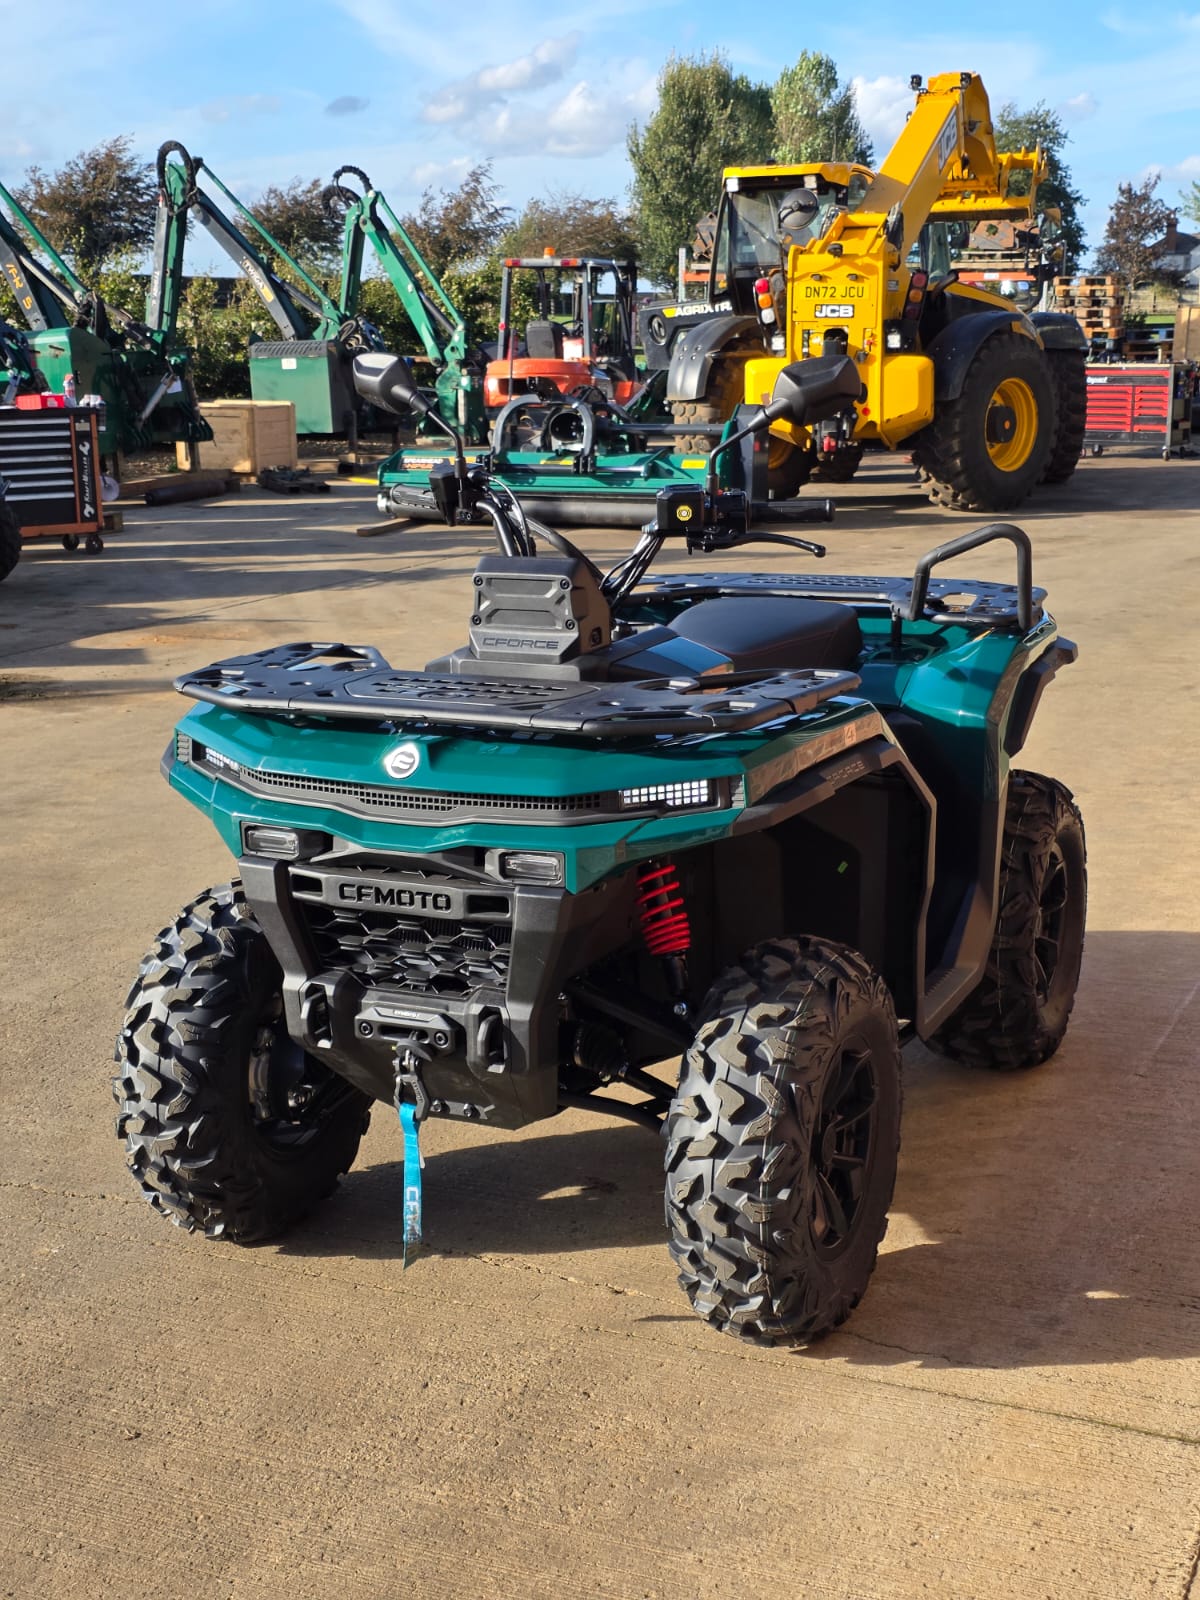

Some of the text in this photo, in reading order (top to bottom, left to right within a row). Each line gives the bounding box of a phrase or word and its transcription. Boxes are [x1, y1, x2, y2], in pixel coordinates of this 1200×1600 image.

[938, 113, 957, 170] JCB
[805, 286, 864, 298] DN72 JCU
[815, 304, 854, 318] JCB
[483, 637, 559, 650] CFORCE
[339, 883, 451, 912] CFMOTO
